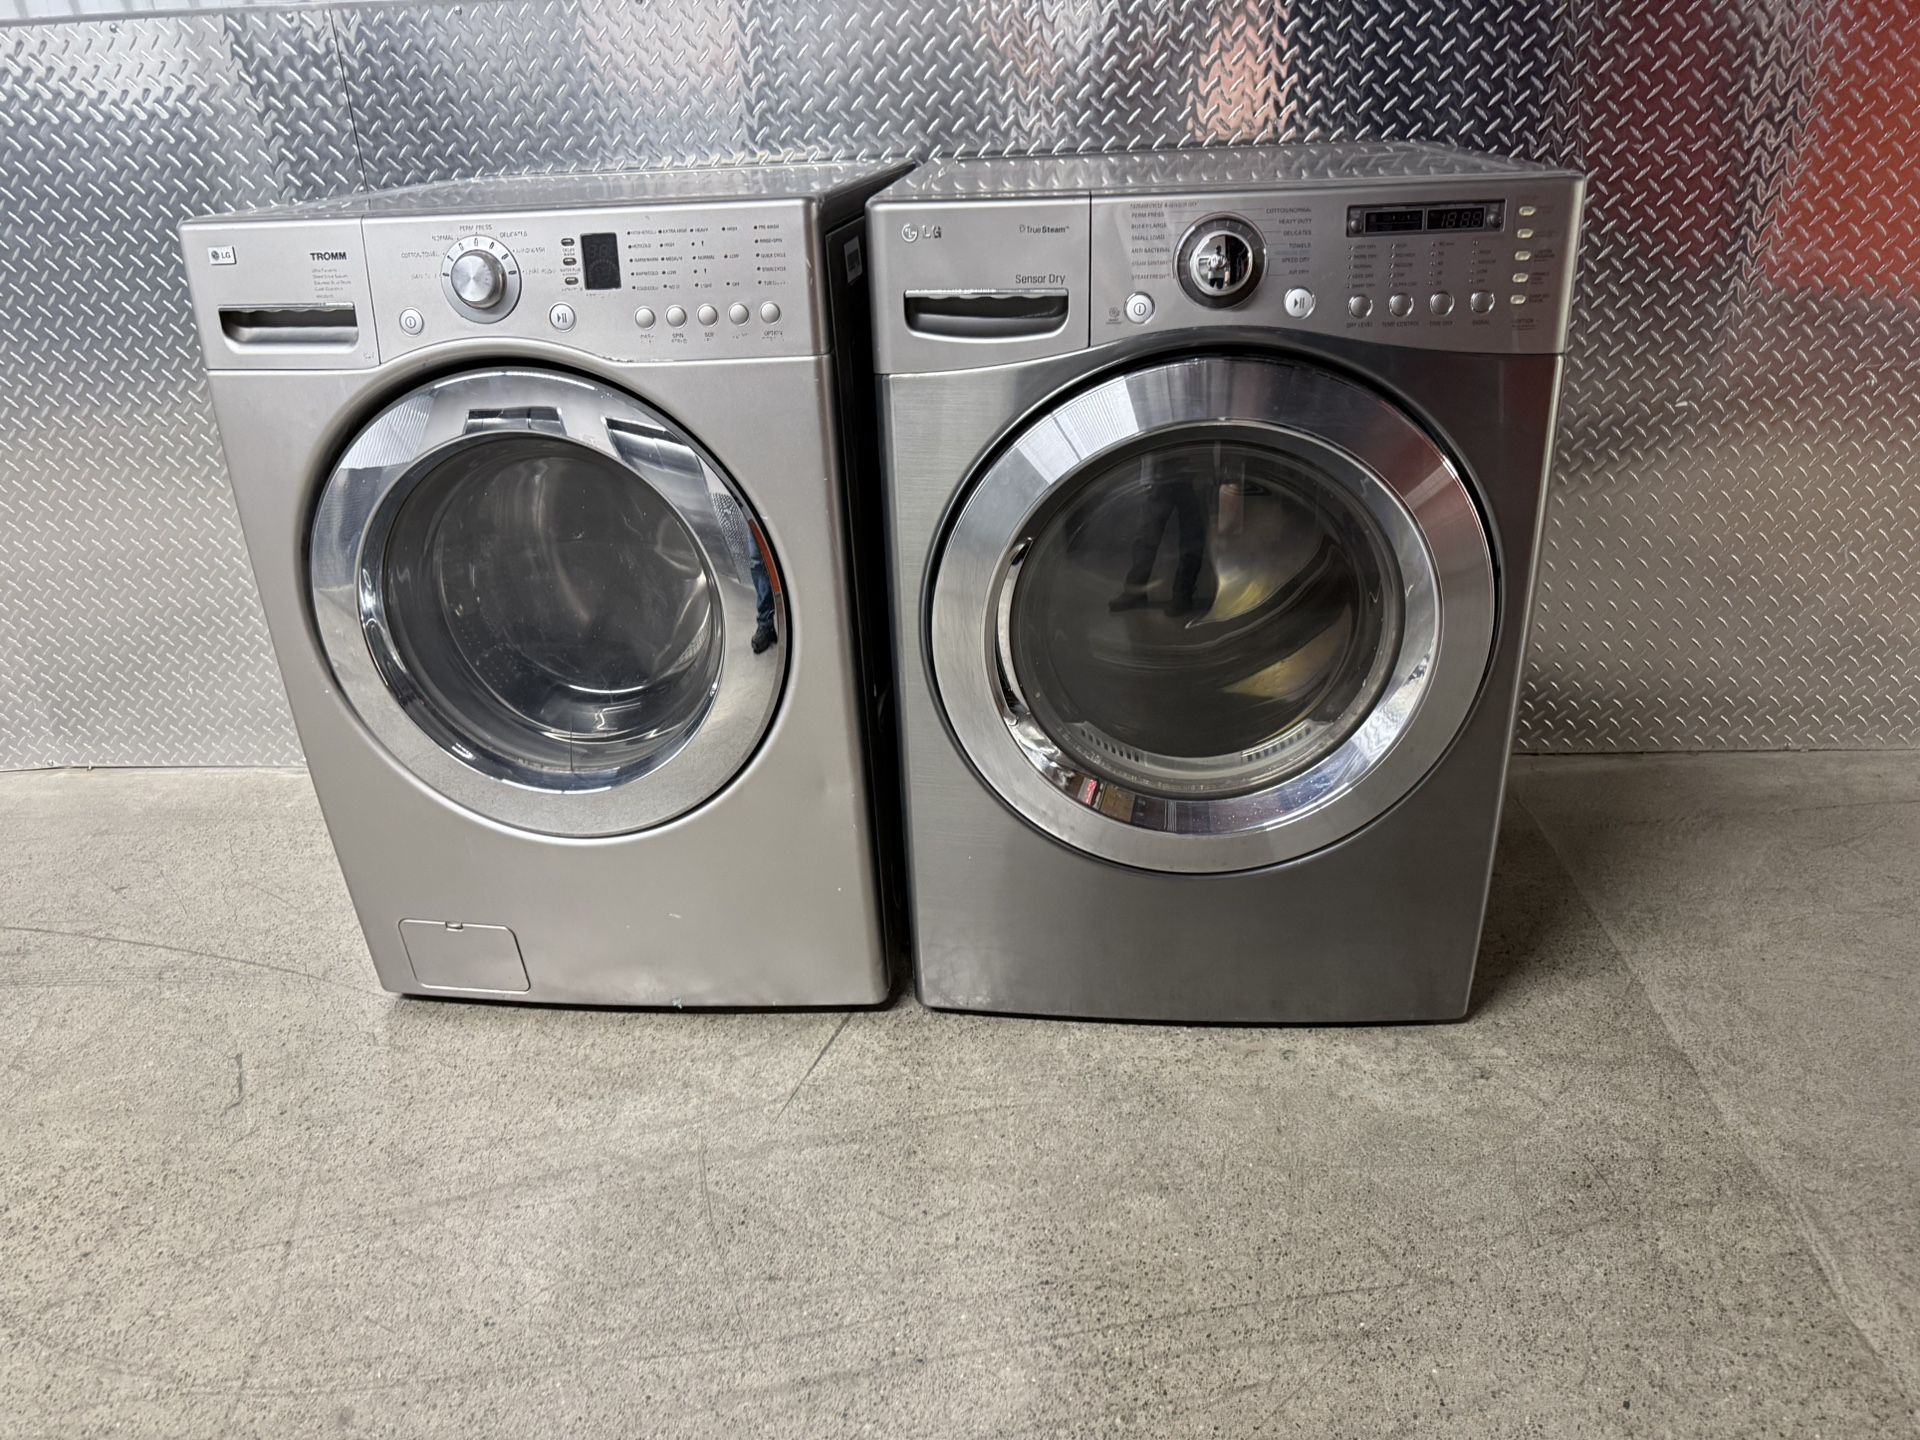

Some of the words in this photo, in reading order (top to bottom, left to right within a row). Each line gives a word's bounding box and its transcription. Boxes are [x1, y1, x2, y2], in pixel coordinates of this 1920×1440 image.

[923, 224, 942, 239] LG
[221, 251, 231, 259] LG
[309, 251, 347, 261] TROMM
[1015, 274, 1046, 284] Sensor
[1049, 273, 1066, 285] Dry
